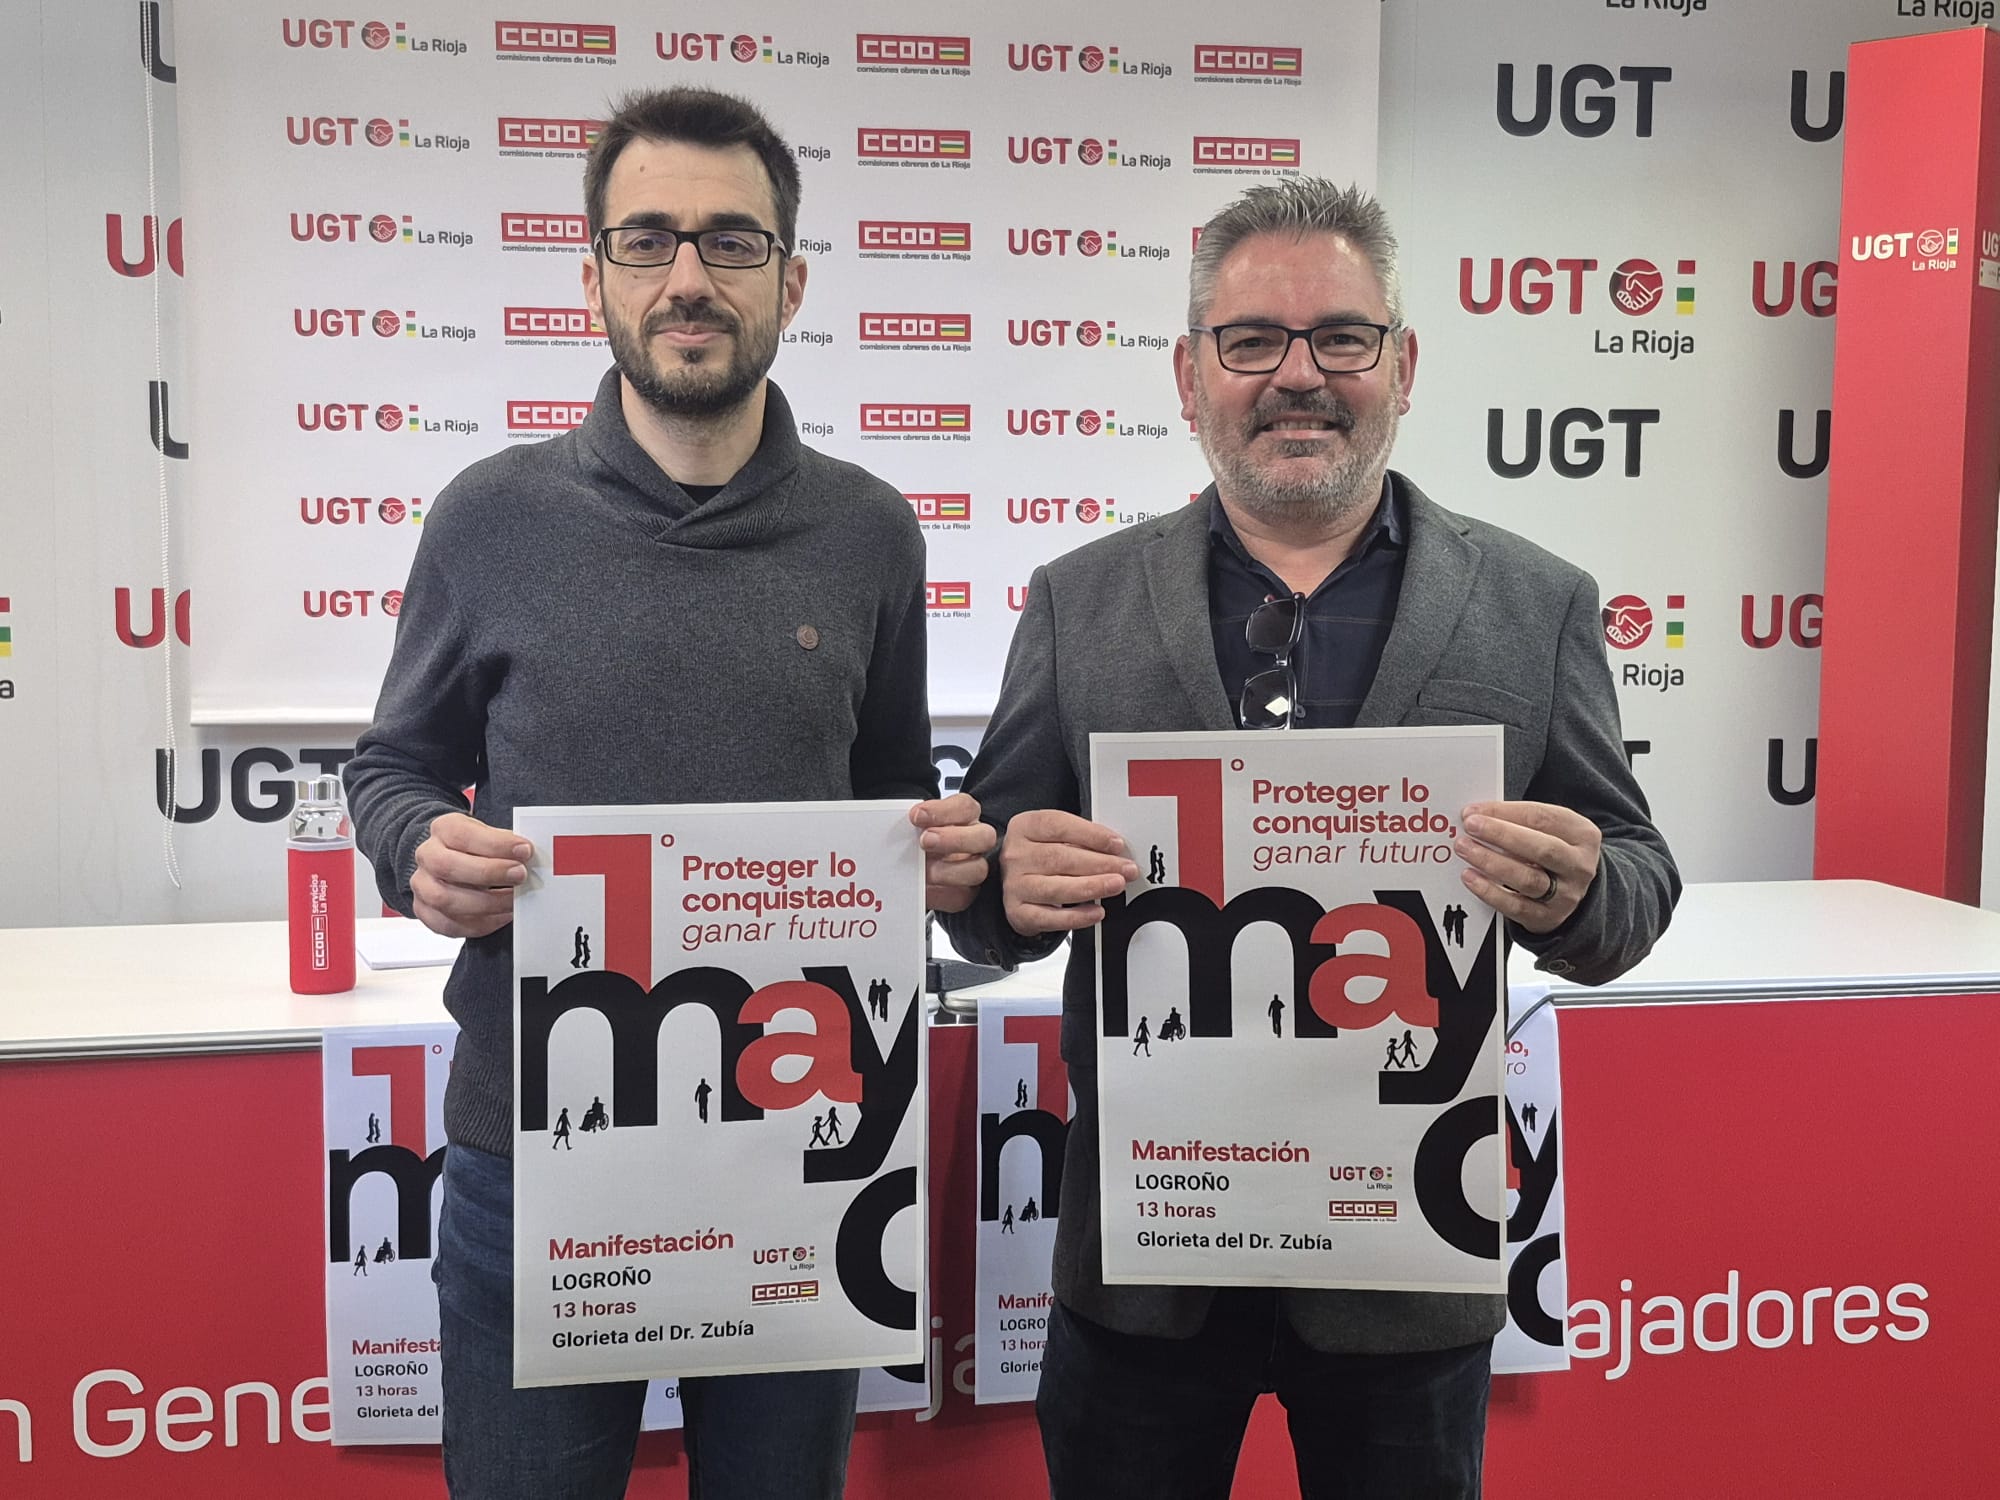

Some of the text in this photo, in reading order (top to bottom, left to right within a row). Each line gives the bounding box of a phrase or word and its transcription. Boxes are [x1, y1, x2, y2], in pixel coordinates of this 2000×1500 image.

[1897, 0, 1995, 24] La Rioja
[282, 18, 467, 56] UGT La Rioja
[501, 27, 578, 48] CCOO
[655, 31, 830, 68] UGT La Rioja
[862, 40, 935, 59] CCOO
[1008, 43, 1172, 78] UGT La Rioja
[1199, 51, 1268, 69] CCOO
[1497, 63, 1672, 137] UGT
[286, 116, 470, 152] UGT La Rioja
[504, 123, 581, 143] CCOO
[863, 134, 935, 153] CCOO
[798, 146, 831, 162] Rioja
[1008, 136, 1171, 170] UGT La Rioja
[1199, 143, 1266, 161] CCOO
[290, 213, 473, 248] UGT La Rioja
[508, 219, 583, 239] CCOO
[864, 227, 936, 245] CCOO
[800, 239, 832, 254] Rioja
[1008, 228, 1170, 261] UGT La Rioja
[1852, 232, 1914, 261] UGT
[1982, 230, 2000, 257] UG
[1912, 259, 1956, 272] La Rioja
[1459, 257, 1598, 315] UGT
[1751, 260, 1839, 318] UG
[294, 308, 476, 342] UGT La Rioja
[510, 312, 586, 332] CCOO
[865, 318, 936, 336] CCOO
[1008, 319, 1169, 350] UGT La Rioja
[782, 331, 833, 346] La Rioja
[1594, 330, 1695, 360] La Rioja
[297, 403, 479, 435] UGT La Rioja
[802, 422, 834, 437] Rioja
[866, 409, 936, 426] CCOO
[1007, 409, 1168, 439] UGT La Rioja
[1486, 407, 1660, 480] UGT
[300, 497, 372, 525] UGT
[1007, 498, 1070, 524] UGT
[1119, 512, 1134, 524] La
[303, 590, 374, 618] UGT
[1740, 593, 1824, 649] UG
[1622, 663, 1685, 692] Rioja
[1253, 777, 1430, 810] Proteger lo
[1253, 807, 1457, 841] conquistado,
[1253, 838, 1452, 872] ganar futuro
[682, 851, 857, 887] Proteger lo
[682, 882, 883, 918] conquistado,
[681, 914, 878, 951] ganar futuro
[1131, 1139, 1310, 1163] Manifestación
[1135, 1171, 1230, 1191] LOGROÑO
[1329, 1166, 1367, 1181] UGT
[1136, 1201, 1217, 1218] 13 horas
[1332, 1203, 1377, 1214] CCOO
[549, 1227, 734, 1261] Manifestación
[1137, 1231, 1333, 1250] Glorieta del Dr. Zubía
[753, 1247, 790, 1265] UGT
[552, 1266, 652, 1291] LOGROÑO
[552, 1301, 637, 1319] 13 horas
[552, 1320, 754, 1348] Glorieta del Dr. Zubía
[1000, 1318, 1046, 1331] LOGRO
[1567, 1270, 1930, 1381] ajadores
[352, 1337, 441, 1355] Manifesta
[1001, 1339, 1017, 1352] 13
[355, 1361, 429, 1377] LOGROÑO
[356, 1385, 418, 1397] 13 horas
[72, 1368, 332, 1459] Gene
[357, 1404, 439, 1418] Glorieta del
